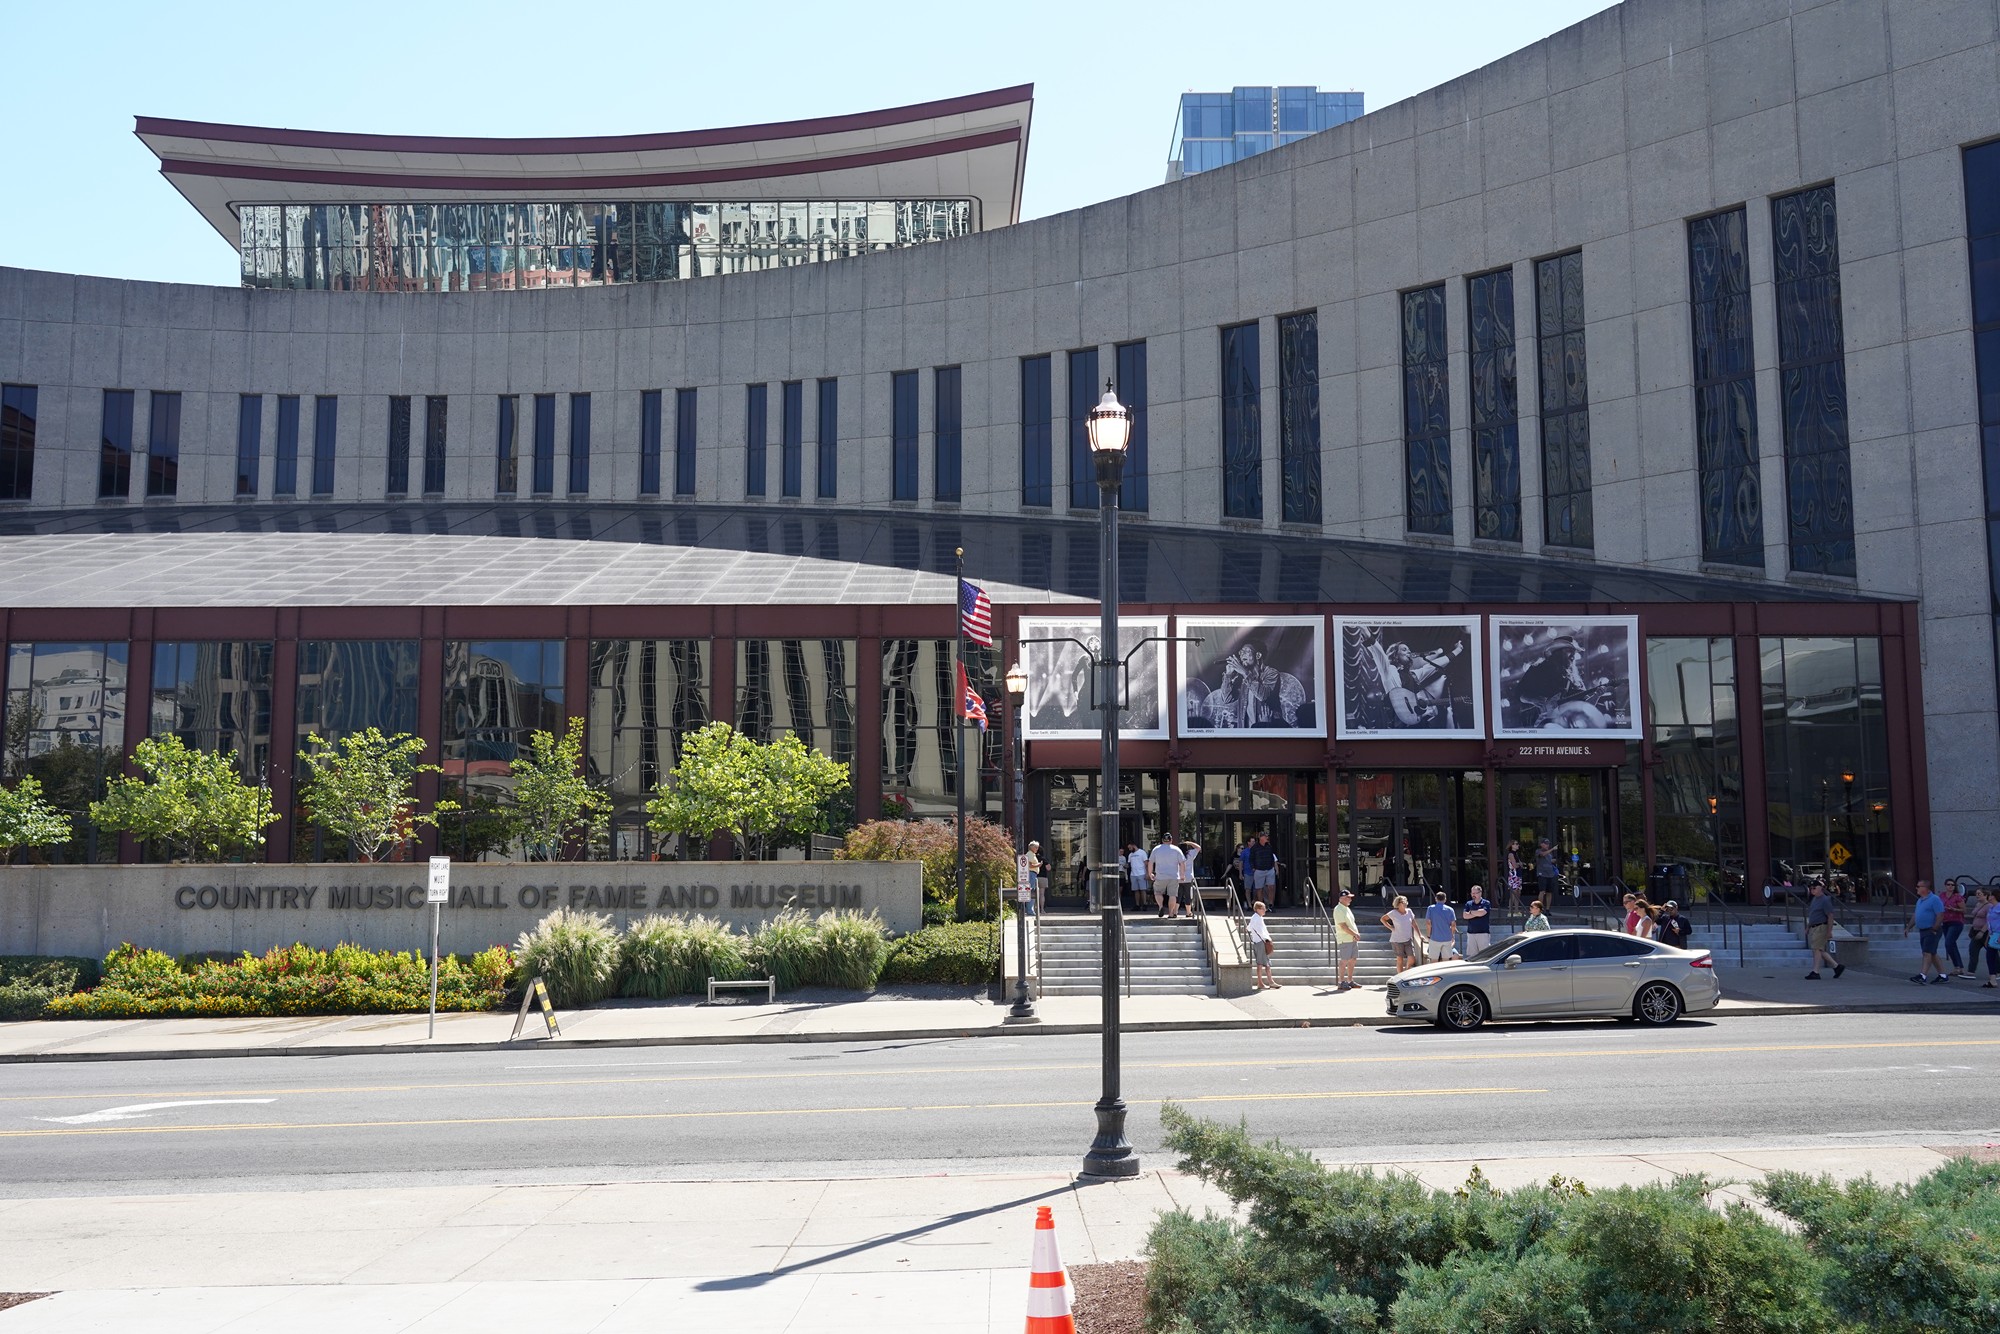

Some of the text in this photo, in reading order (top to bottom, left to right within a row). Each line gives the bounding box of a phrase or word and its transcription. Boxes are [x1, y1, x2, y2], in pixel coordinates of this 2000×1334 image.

[434, 876, 445, 884] MUST
[175, 886, 317, 910] COUNTRY
[328, 886, 424, 910] MUSIC
[518, 885, 559, 909] OF
[568, 885, 647, 909] FAME
[657, 885, 719, 909] AND
[731, 885, 862, 909] MUSEUM
